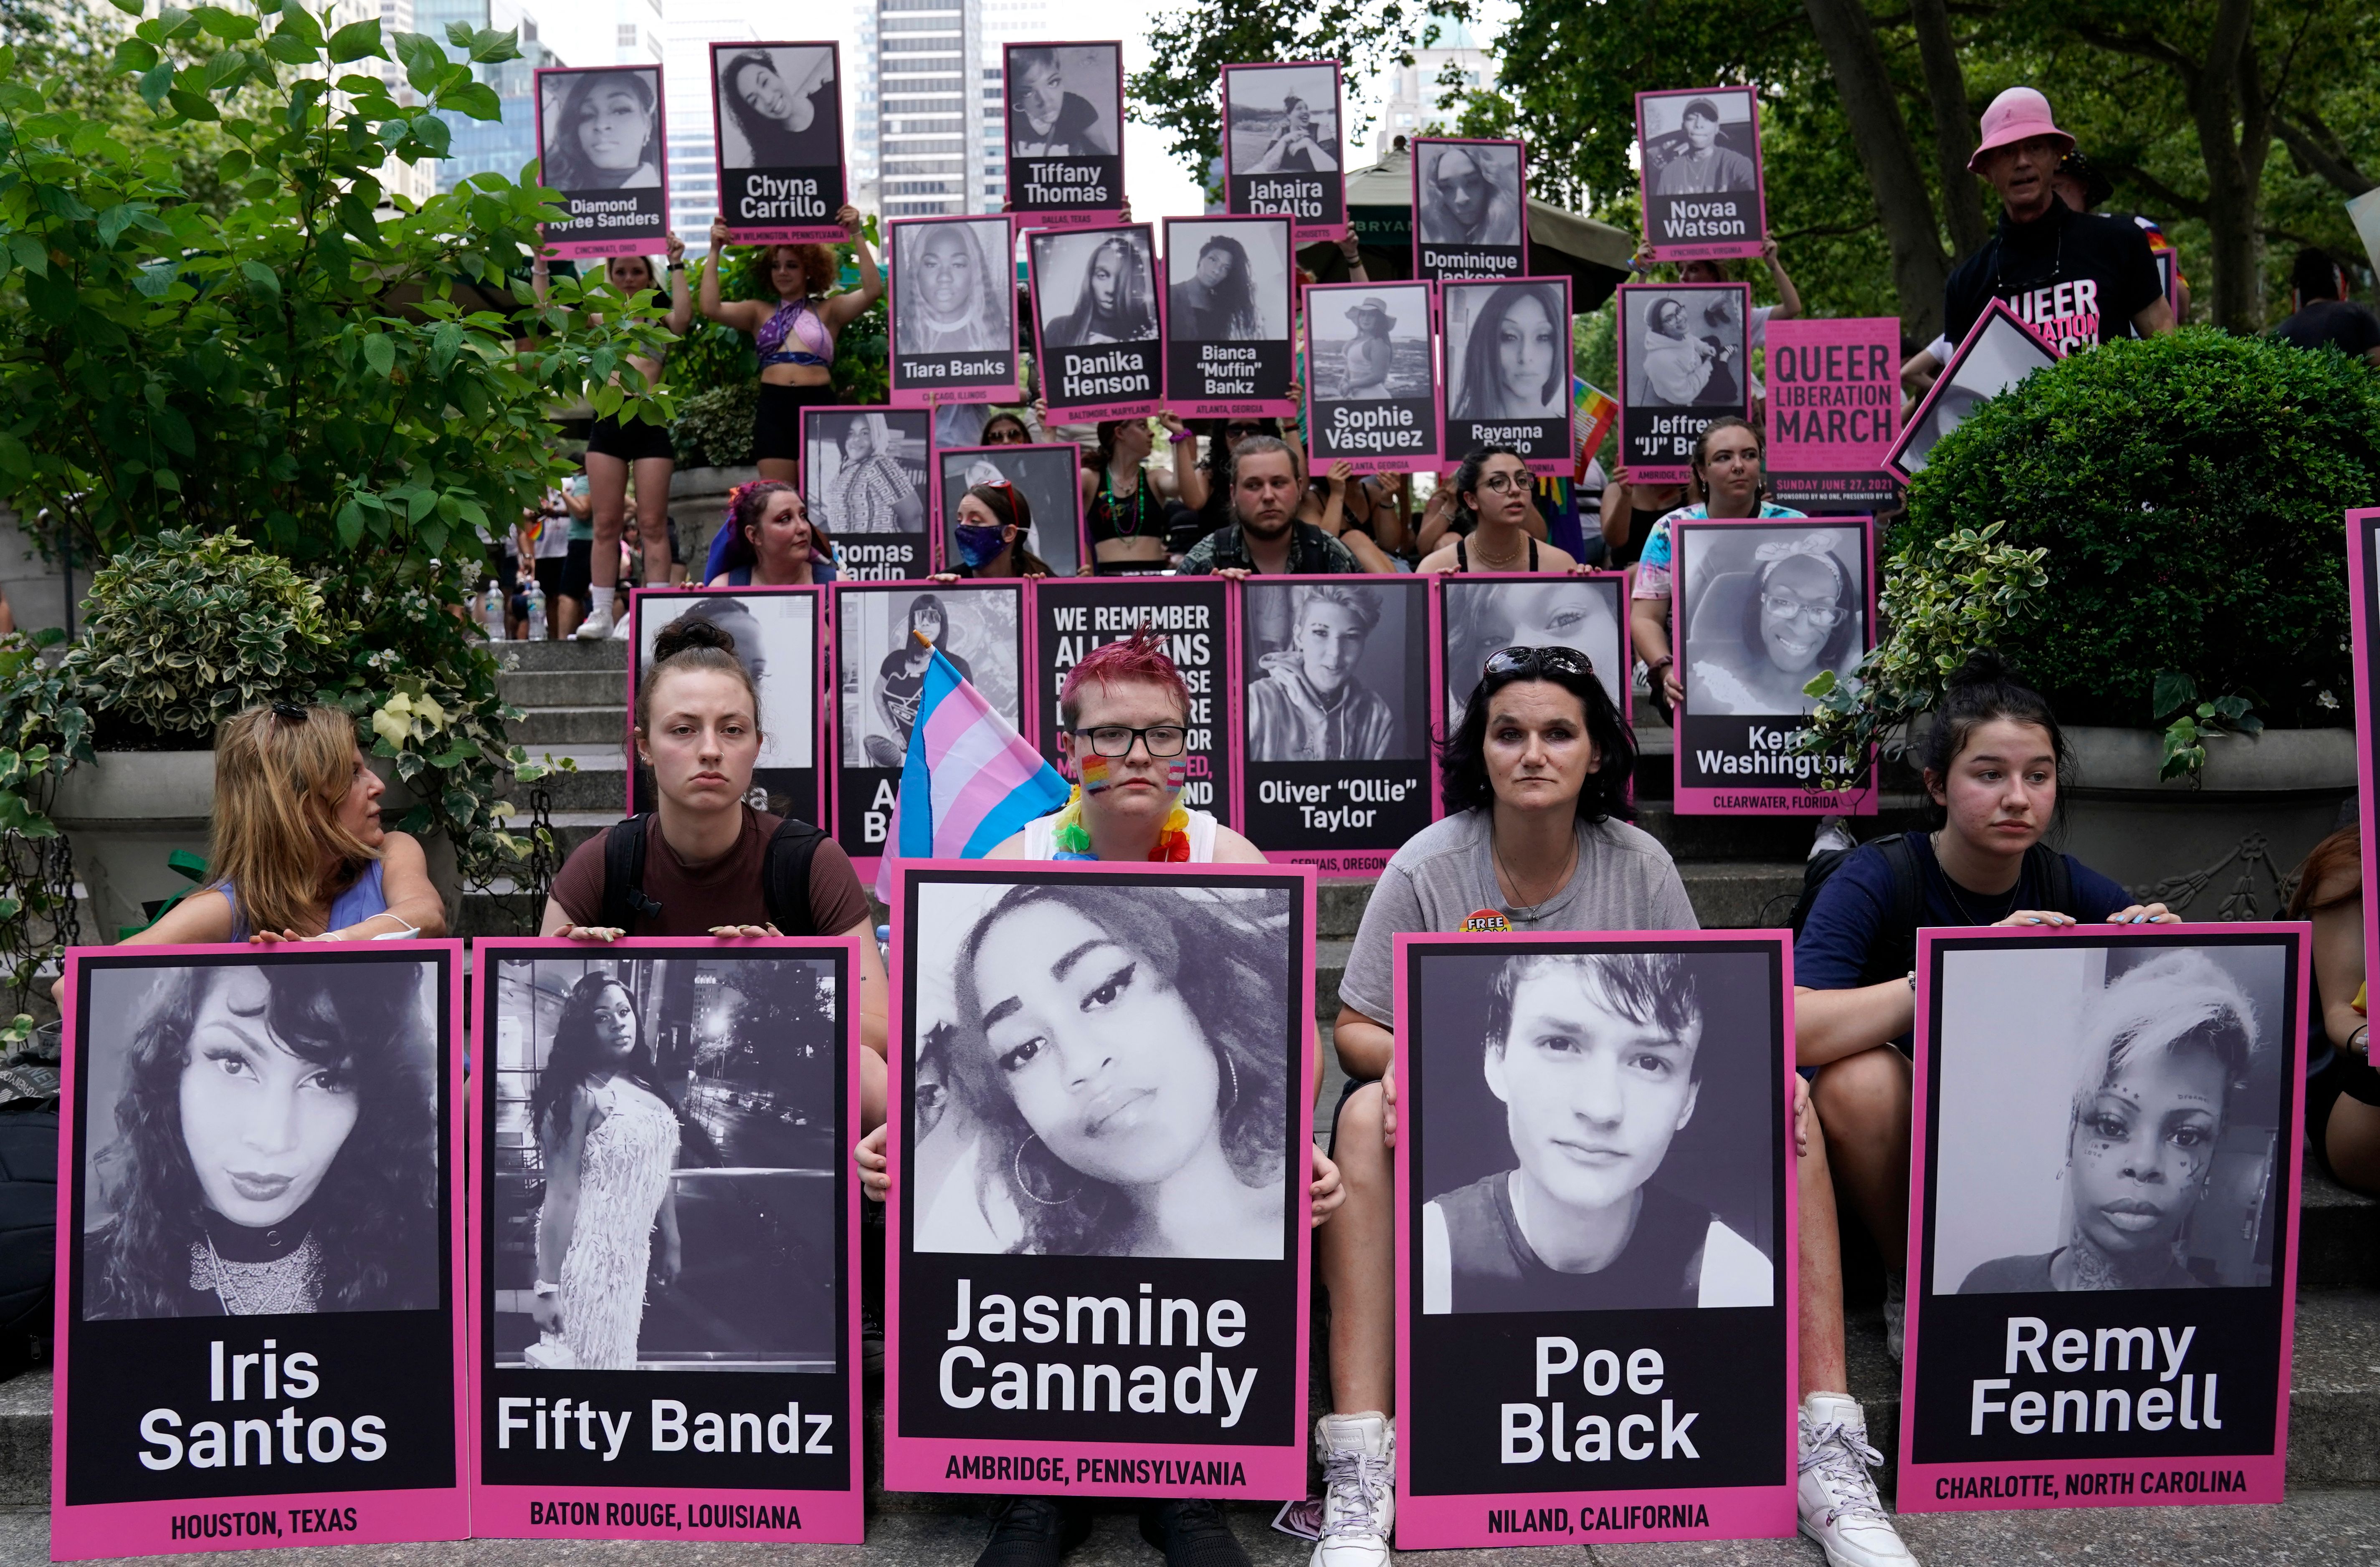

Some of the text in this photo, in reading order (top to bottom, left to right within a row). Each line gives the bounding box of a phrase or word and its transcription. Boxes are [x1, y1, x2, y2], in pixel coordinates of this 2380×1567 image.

[1029, 163, 1101, 186] Tiffany
[747, 175, 818, 200] Chyna
[1023, 184, 1107, 203] Thomas
[1248, 179, 1323, 200] Jahaira
[571, 197, 637, 214] Diamond
[740, 196, 826, 218] Carrillo
[1251, 199, 1322, 217] DeAlto
[1671, 200, 1737, 219] Novaa
[598, 212, 659, 228] Sanders
[1042, 215, 1091, 224] DALLAS, TEXAS
[1663, 218, 1745, 238] Watson
[1424, 250, 1517, 272] Dominique
[2004, 279, 2099, 325] UEER
[1065, 351, 1143, 376] Danika
[1202, 345, 1256, 360] Bianca
[1775, 345, 1890, 383] QUEER
[902, 359, 1005, 378] Tiara Banks
[1063, 374, 1150, 397] Henson
[1205, 379, 1254, 394] Bankz
[1776, 385, 1891, 407] LIBERATION
[1069, 405, 1151, 420] BALTIMORE, MARYLAND
[1196, 404, 1263, 414] ATLANTA, GEORGIA
[1334, 406, 1413, 431] Sophie
[1472, 424, 1543, 442] Rayanna
[1776, 409, 1892, 443] MARCH
[1325, 427, 1423, 452] Vásquez
[1377, 461, 1409, 470] GEORGIA
[1638, 470, 1678, 480] AMBRIDGE,
[1777, 480, 1892, 491] SUNDAY JUNE 27, 2021
[846, 563, 905, 581] ardin
[1053, 605, 1210, 631] WE REMEMBER
[1696, 750, 1854, 780] Washington
[1259, 780, 1331, 804] Oliver
[1714, 796, 1838, 810] CLEARWATER, FLORIDA
[1299, 805, 1377, 832] Taylor
[1343, 858, 1387, 869] OREGON
[1467, 917, 1504, 930] FREE
[947, 1279, 1246, 1348] Jasmine
[2005, 1317, 2196, 1382] Remy
[211, 1339, 319, 1401] Iris
[1536, 1336, 1664, 1397] Poe
[939, 1345, 1258, 1428] Cannady
[1971, 1373, 2221, 1436] Fennell
[139, 1406, 387, 1471] Santos
[499, 1397, 833, 1462] Fifty Bandz
[1501, 1399, 1700, 1463] Black
[945, 1455, 1246, 1486] AMBRIDGE, PENNSYLVANIA
[1936, 1470, 2246, 1500] CHARLOTTE, NORTH CAROLINA
[171, 1507, 357, 1540] HOUSTON, TEXAS
[531, 1502, 802, 1532] BATON ROUGE, LOUISIANA
[1488, 1504, 1710, 1536] NILAND, CALIFORNIA
